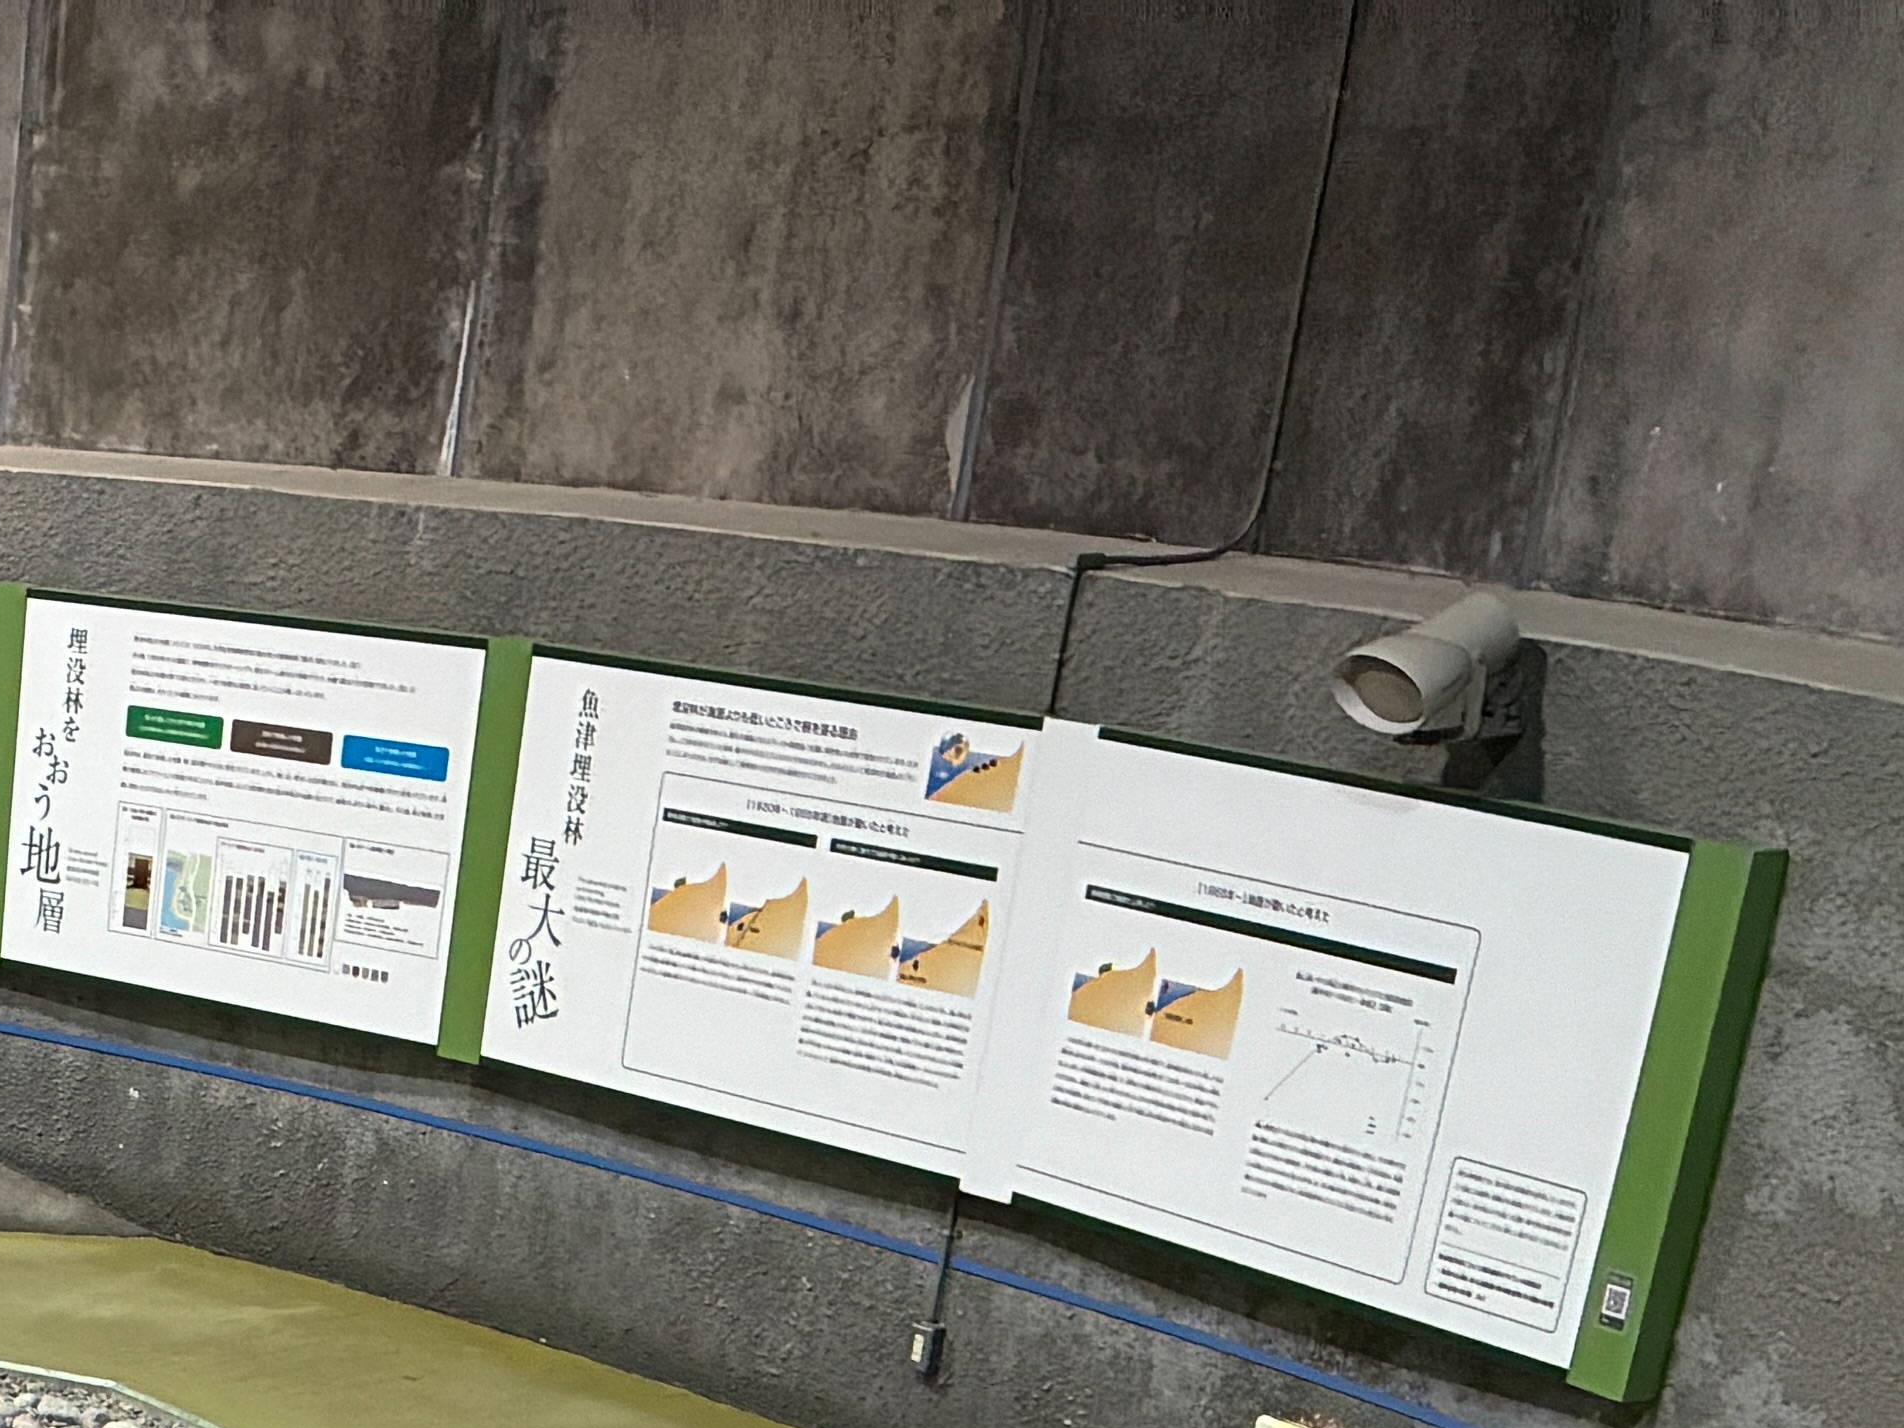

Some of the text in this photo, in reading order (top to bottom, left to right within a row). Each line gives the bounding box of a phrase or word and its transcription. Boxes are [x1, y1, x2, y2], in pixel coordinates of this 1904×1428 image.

[62, 626, 89, 742] 埋没林を
[563, 687, 601, 846] 魚津埋没林
[509, 837, 566, 1029] 最大の謎
